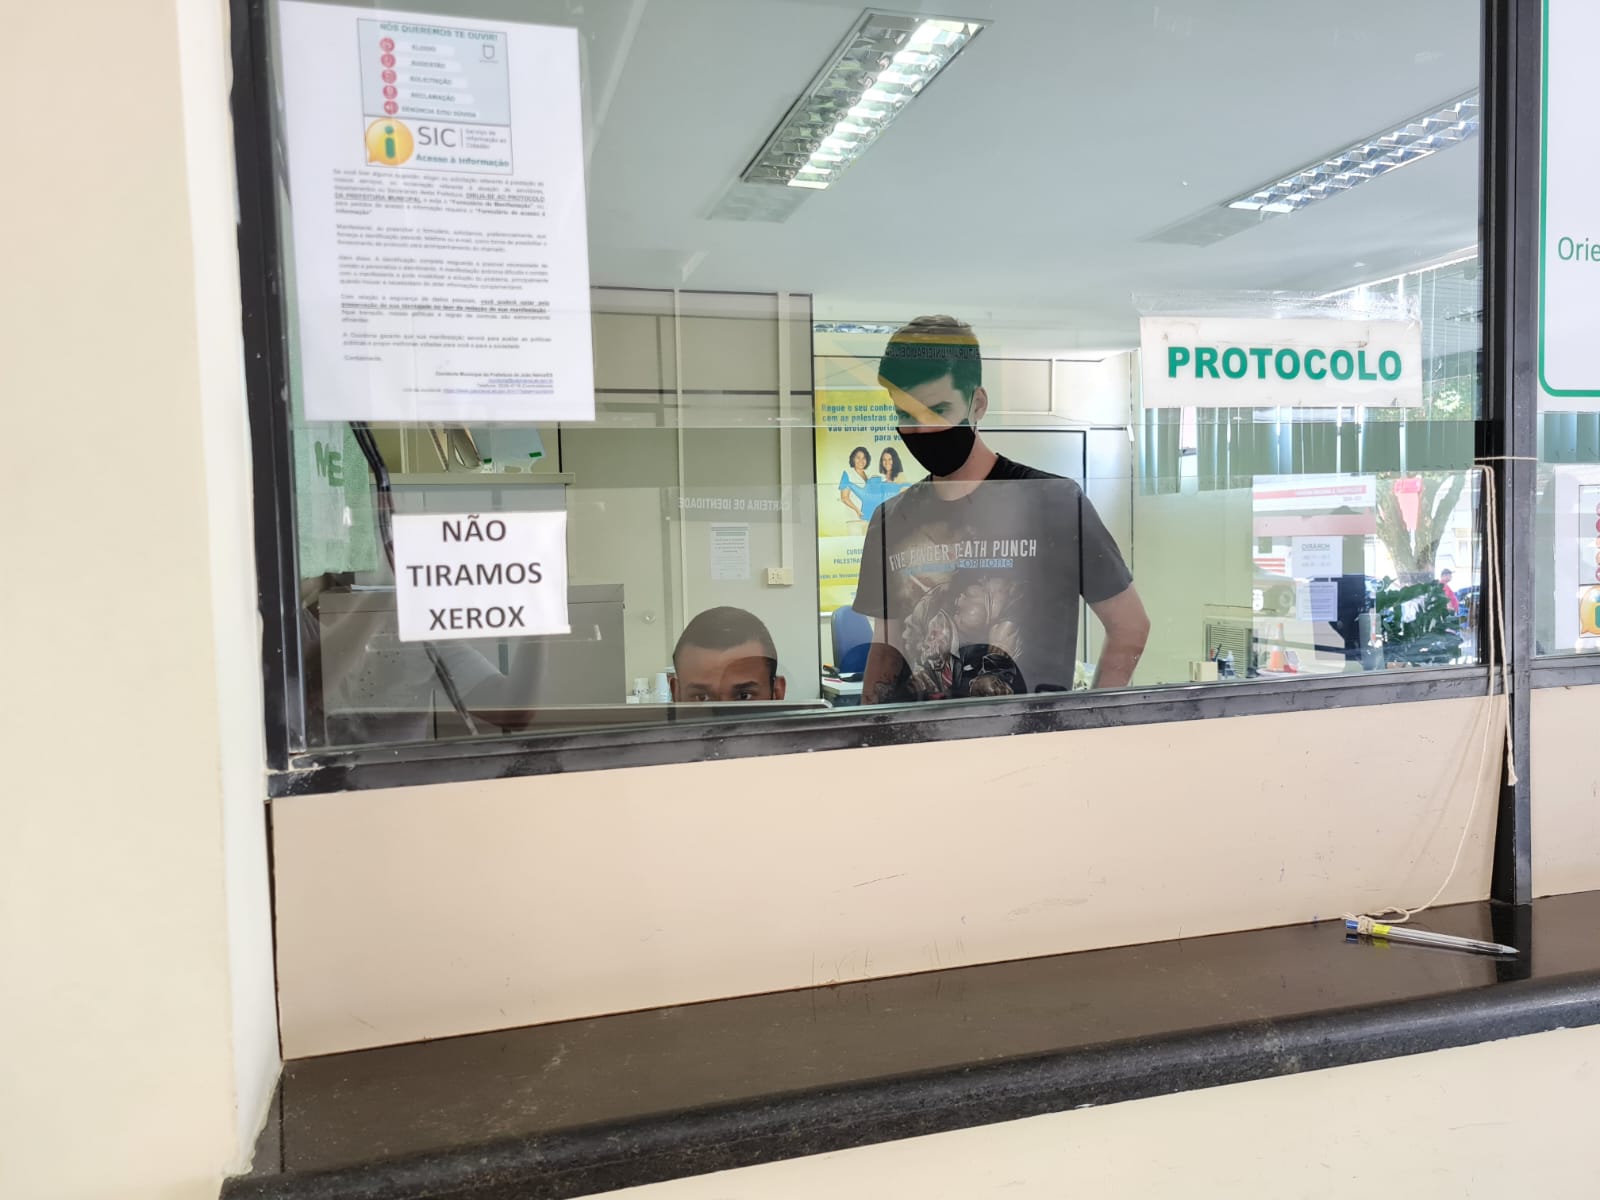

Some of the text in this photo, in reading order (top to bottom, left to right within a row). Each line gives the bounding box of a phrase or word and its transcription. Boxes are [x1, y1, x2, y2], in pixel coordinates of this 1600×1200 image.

[401, 24, 451, 38] QUEREMOS
[417, 126, 457, 148] SIC
[415, 153, 449, 163] Acesso
[1558, 236, 1600, 261] Orie
[1167, 346, 1403, 381] PROTOCOLO
[851, 413, 887, 423] palestras
[874, 434, 892, 442] para
[442, 514, 506, 542] NÃO
[910, 543, 951, 563] FINGER
[991, 539, 1037, 558] PUNCH
[406, 562, 542, 587] TIRAMOS
[429, 606, 525, 631] XEROX
